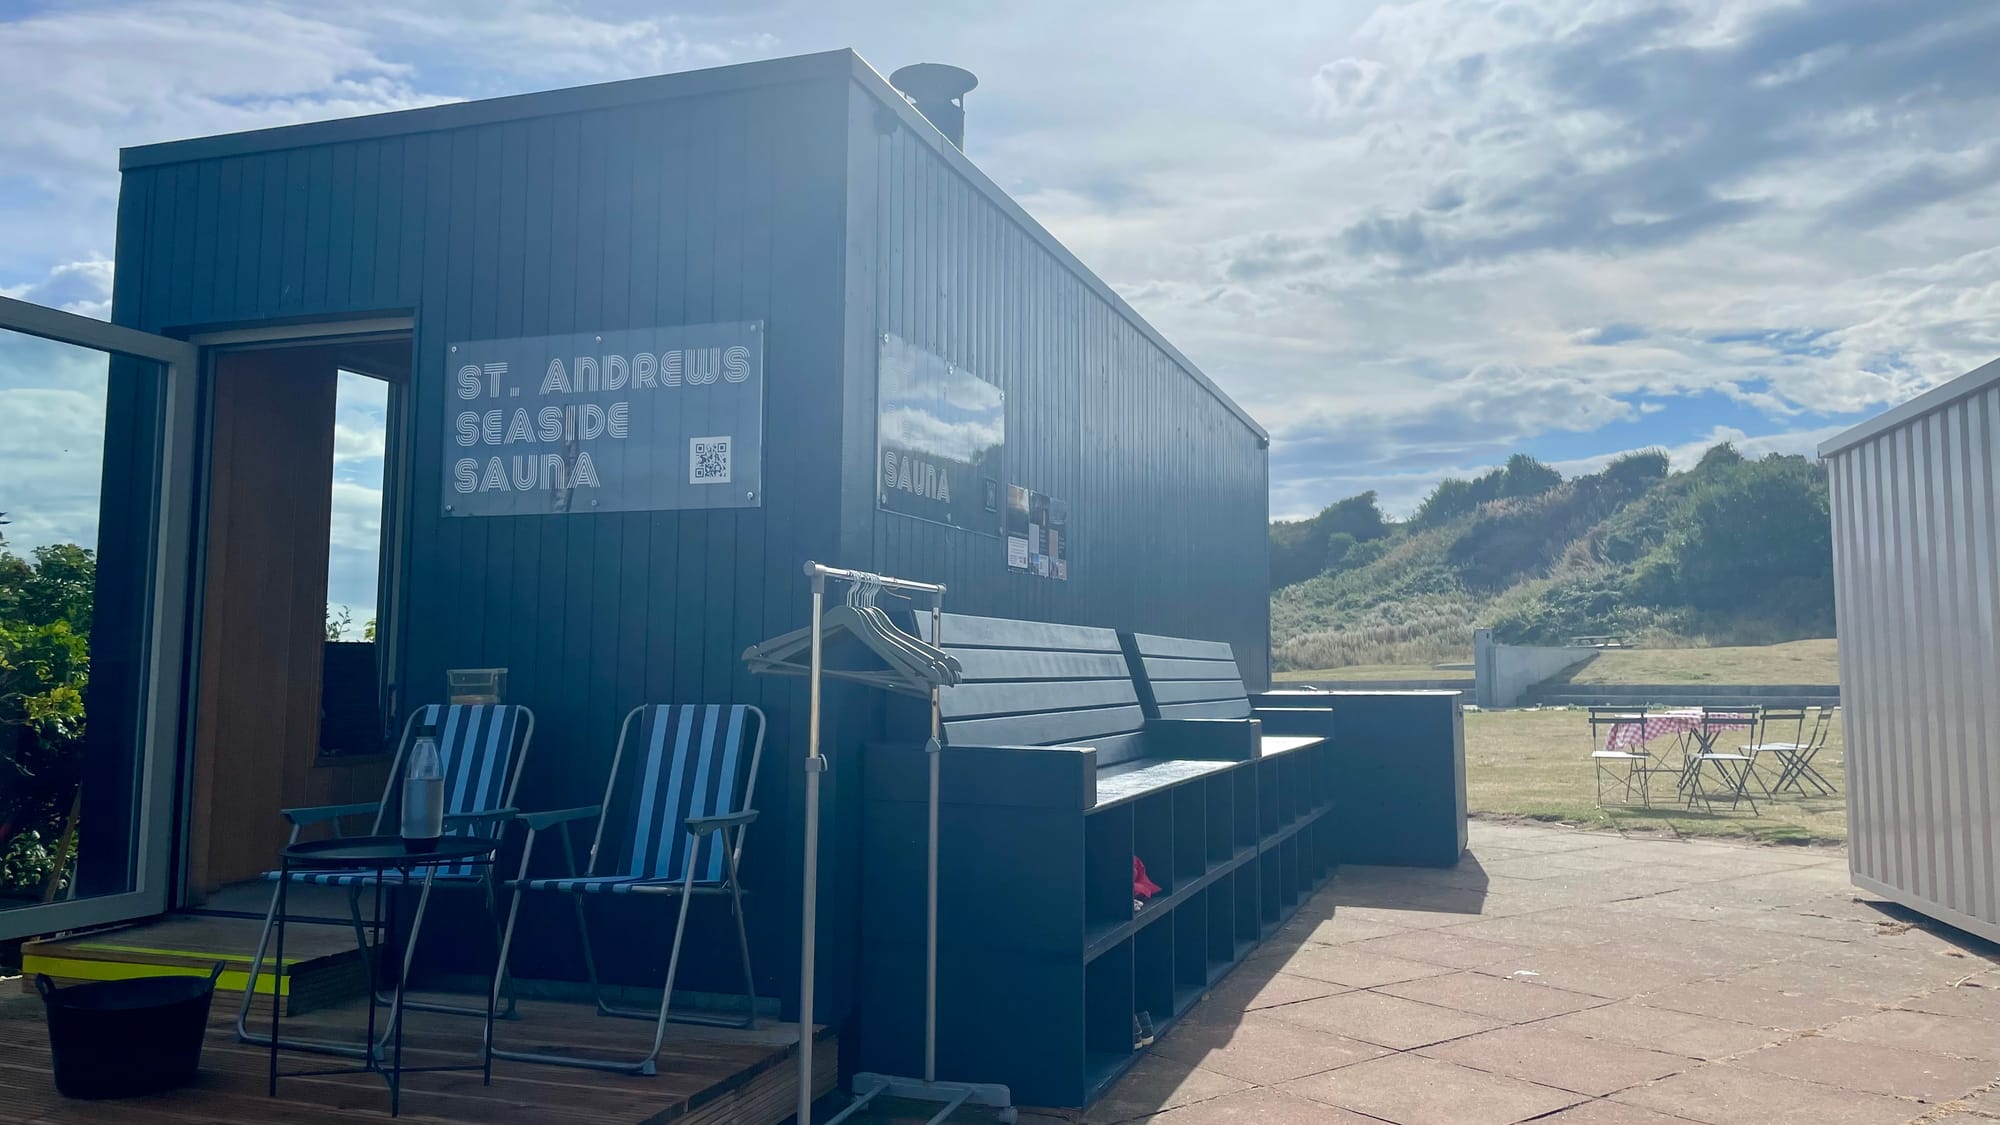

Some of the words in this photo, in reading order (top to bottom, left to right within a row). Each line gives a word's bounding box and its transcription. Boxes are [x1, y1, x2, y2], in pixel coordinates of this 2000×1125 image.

[457, 362, 520, 400] ST.
[539, 345, 751, 396] ANDREWS
[455, 401, 629, 447] SEASIDE
[454, 451, 600, 493] SAUNA
[884, 451, 950, 503] SAUNA
